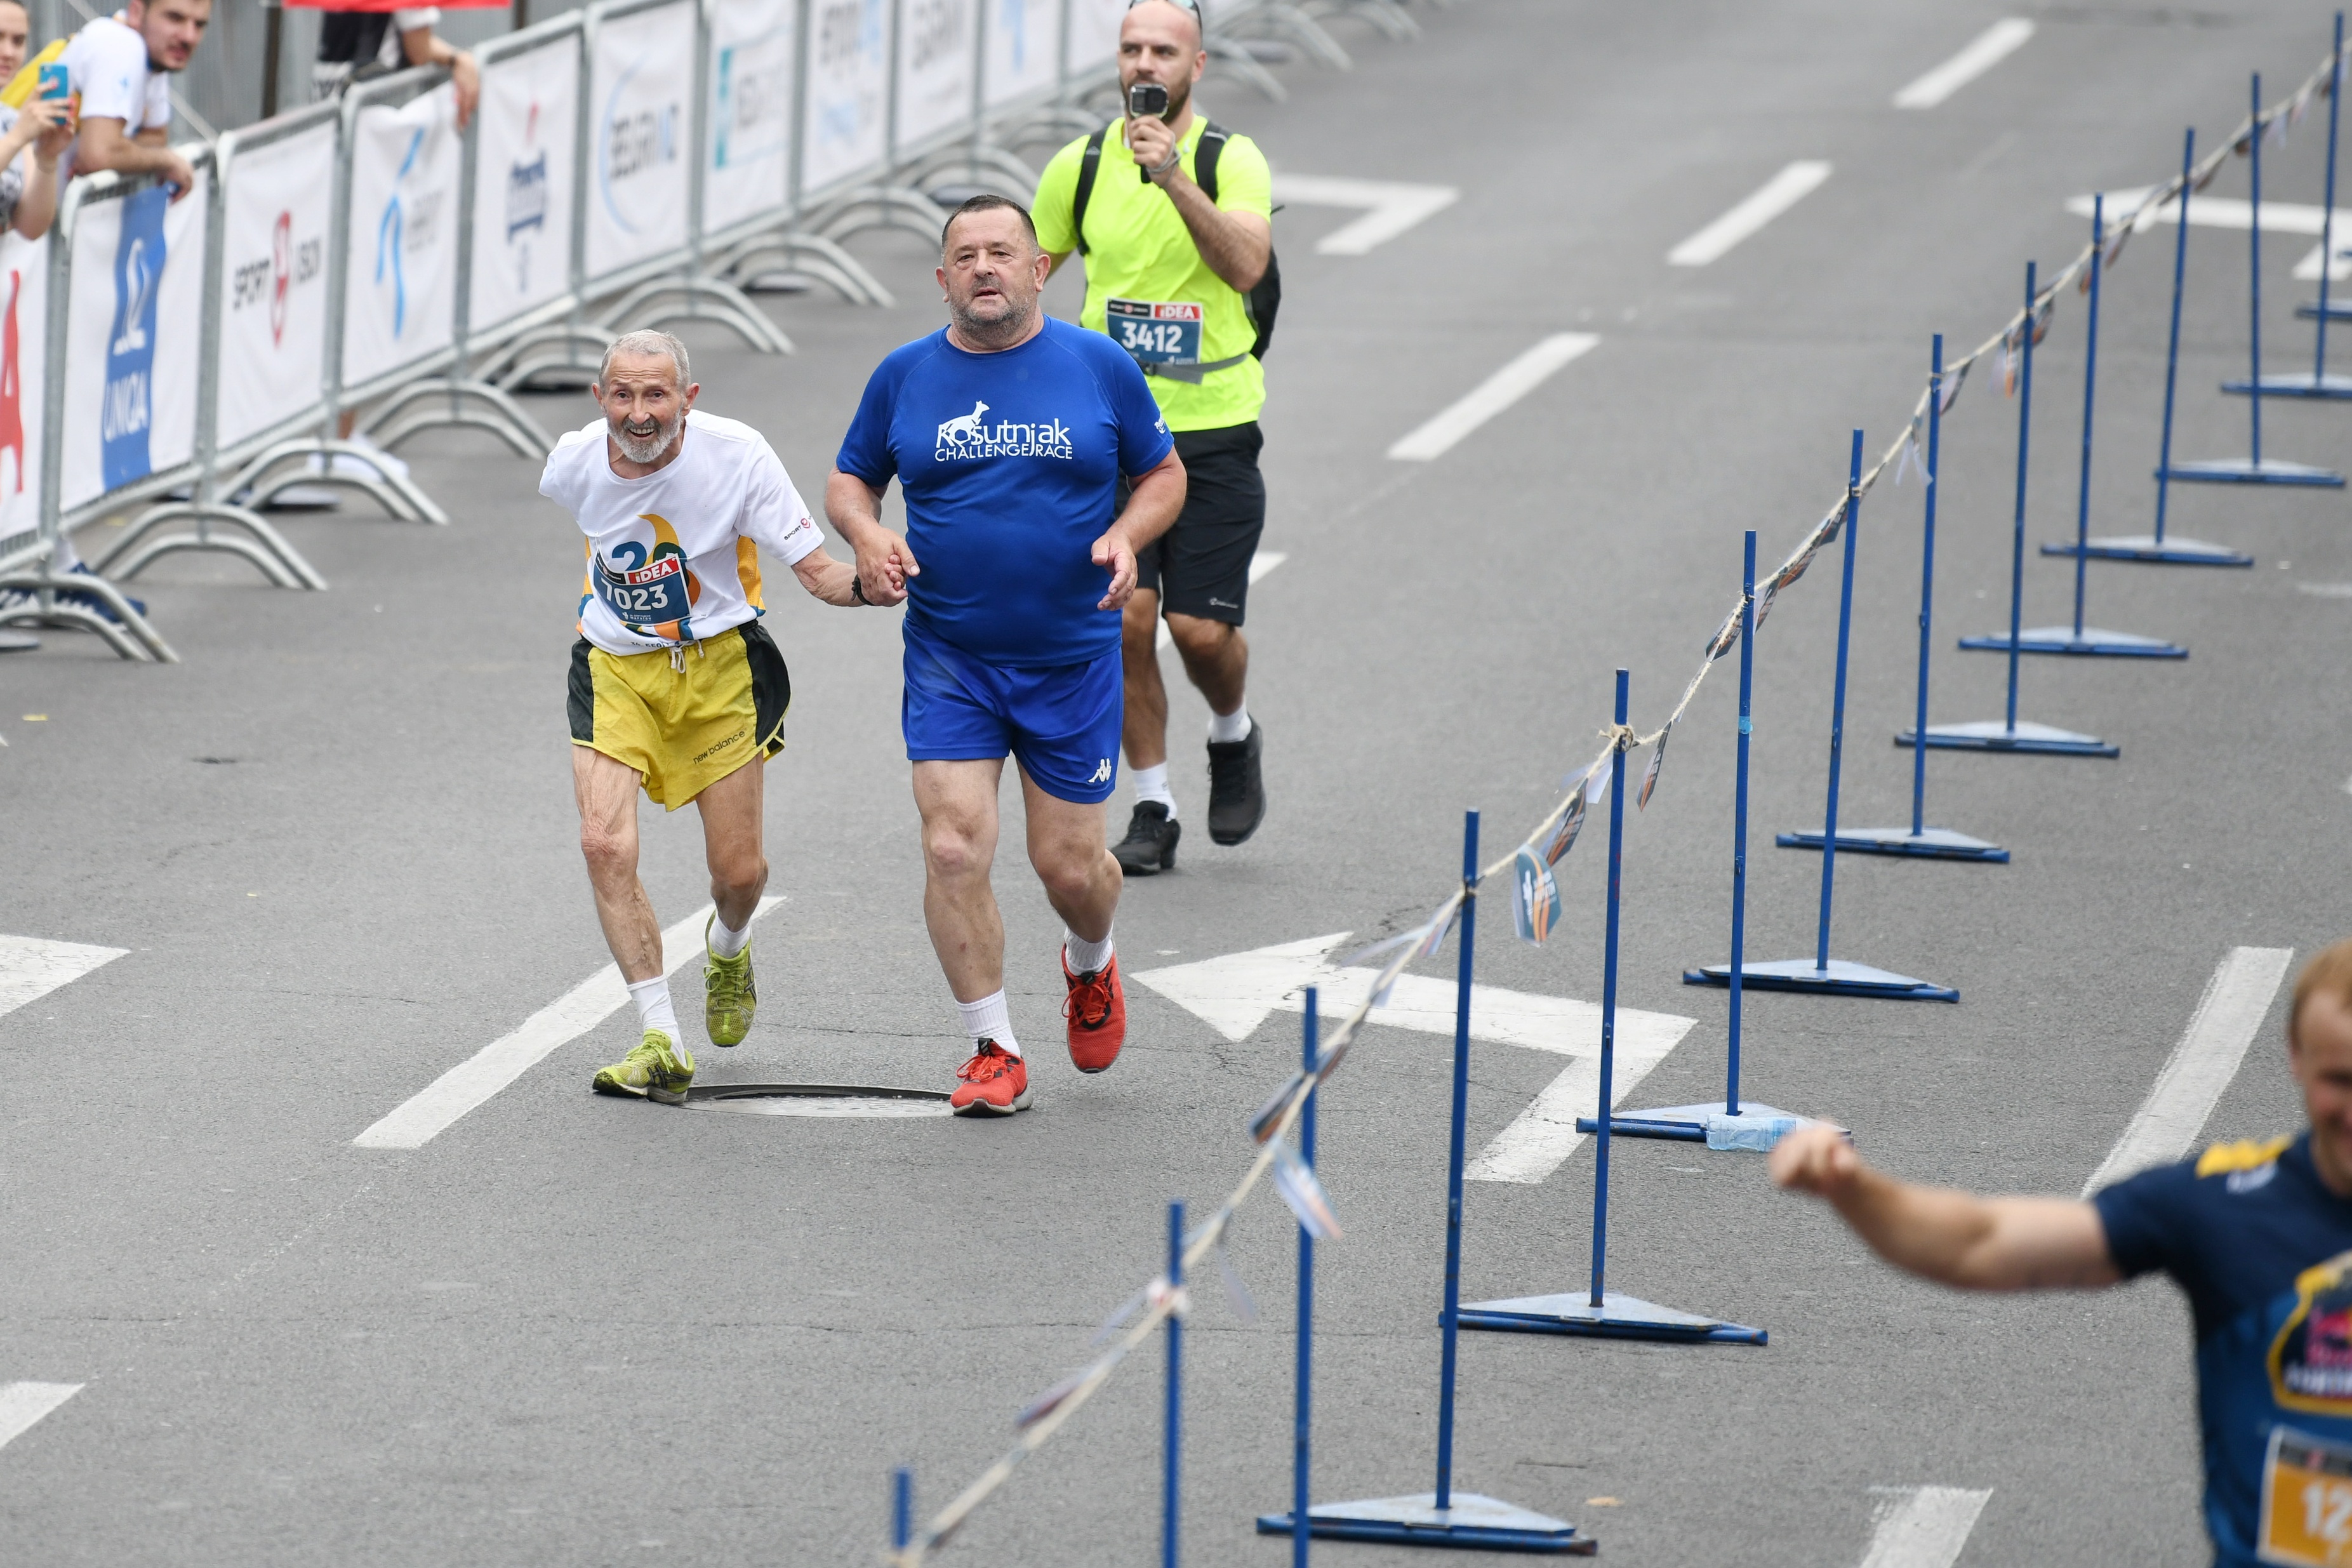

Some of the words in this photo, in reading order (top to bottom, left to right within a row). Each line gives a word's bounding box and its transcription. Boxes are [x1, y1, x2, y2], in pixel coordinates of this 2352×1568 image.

[1122, 321, 1183, 353] 3412
[934, 444, 1029, 462] CHALLENGE
[1035, 444, 1073, 460] RACE
[784, 525, 802, 540] SPORT
[601, 578, 668, 611] 7023
[693, 751, 708, 764] new
[708, 731, 745, 755] balance
